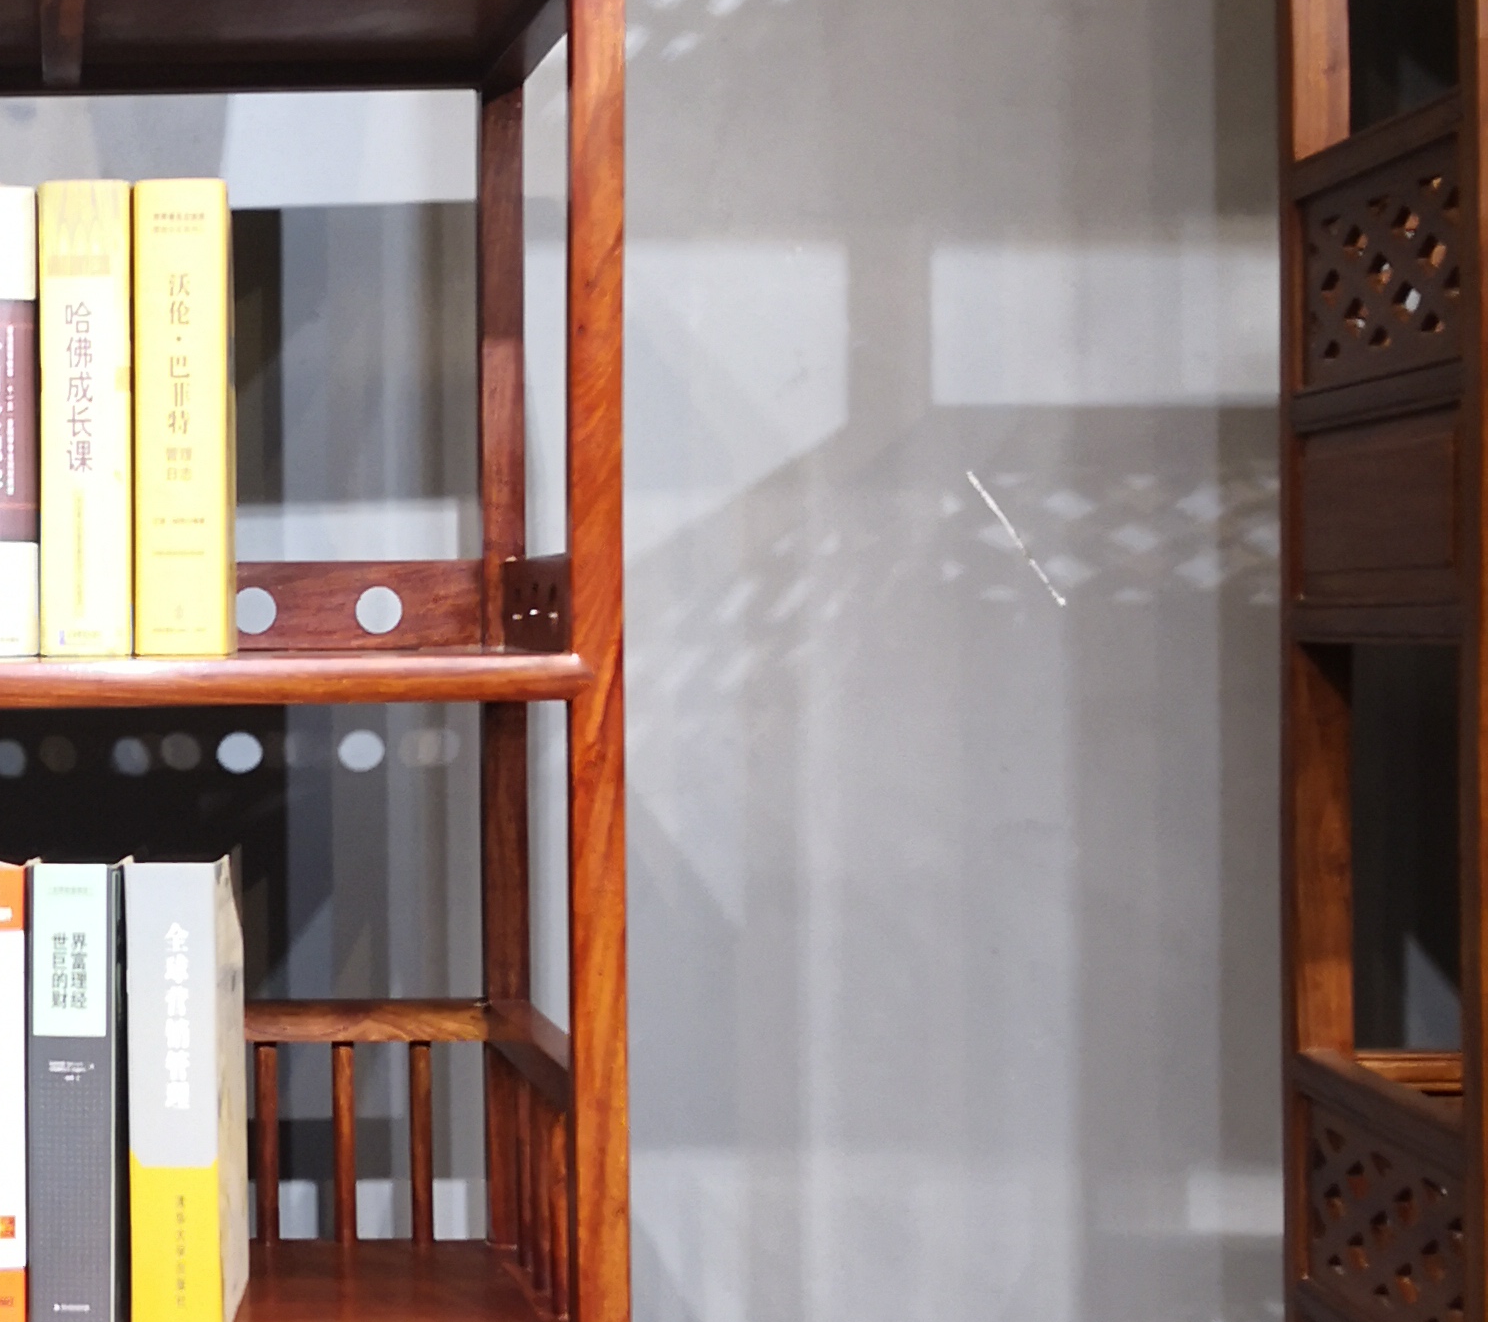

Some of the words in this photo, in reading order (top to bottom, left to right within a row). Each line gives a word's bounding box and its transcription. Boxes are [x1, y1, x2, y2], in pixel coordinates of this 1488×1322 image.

[65, 301, 94, 473] 哈佛成长课
[164, 921, 191, 1110] 全球营销管理
